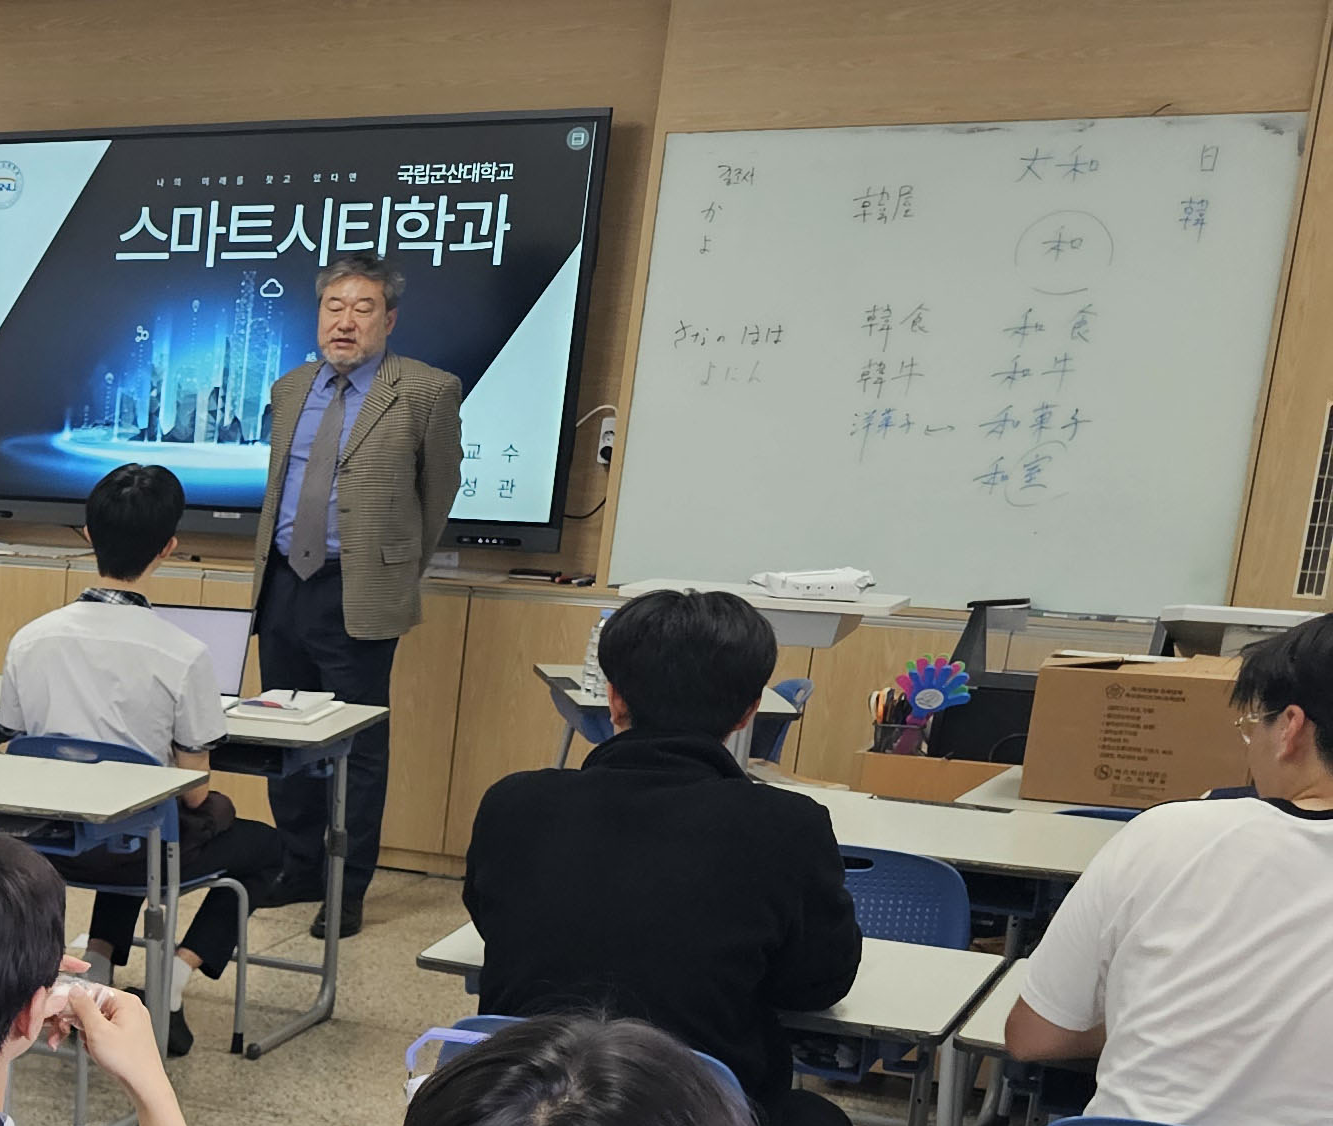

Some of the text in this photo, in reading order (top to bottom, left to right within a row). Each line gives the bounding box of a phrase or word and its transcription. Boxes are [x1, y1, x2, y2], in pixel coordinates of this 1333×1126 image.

[1200, 144, 1219, 172] 日
[156, 178, 182, 187] 나의
[265, 174, 291, 185] 찾고
[397, 161, 514, 185] 국립군산대학교
[115, 193, 511, 268] 스마트시티학과
[1041, 225, 1083, 261] 和
